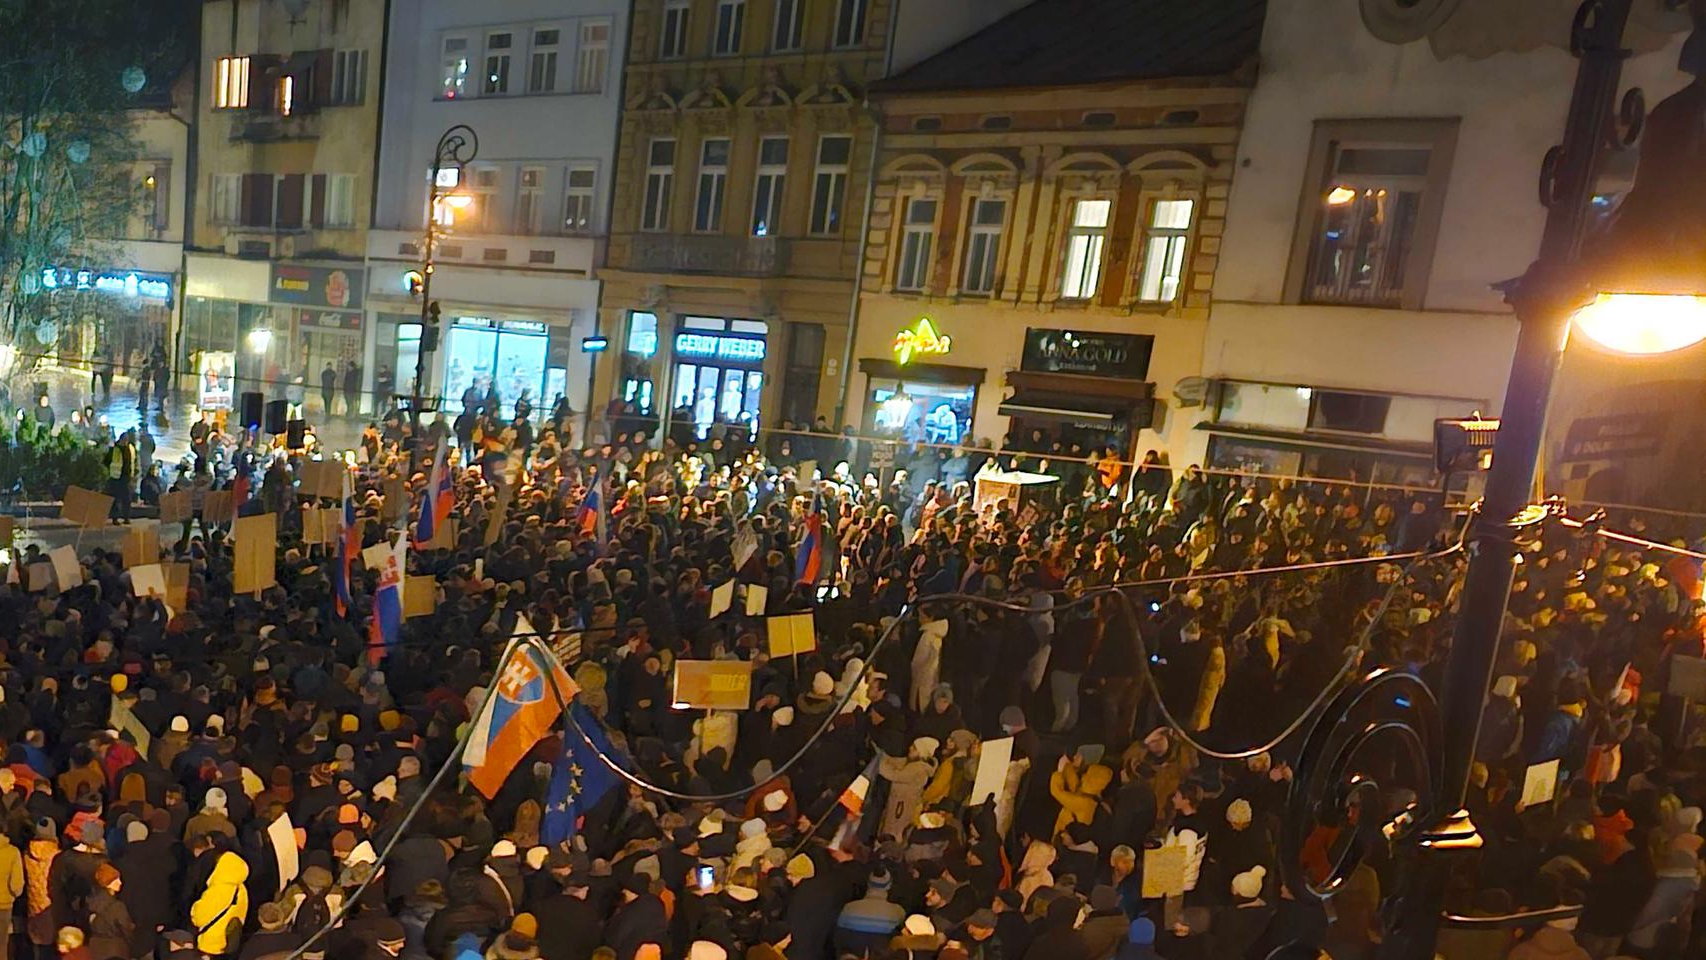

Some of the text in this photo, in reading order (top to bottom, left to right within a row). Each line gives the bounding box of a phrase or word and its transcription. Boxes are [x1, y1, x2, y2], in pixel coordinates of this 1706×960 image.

[676, 333, 765, 359] GERRY WEBER
[1083, 348, 1127, 362] GOLD
